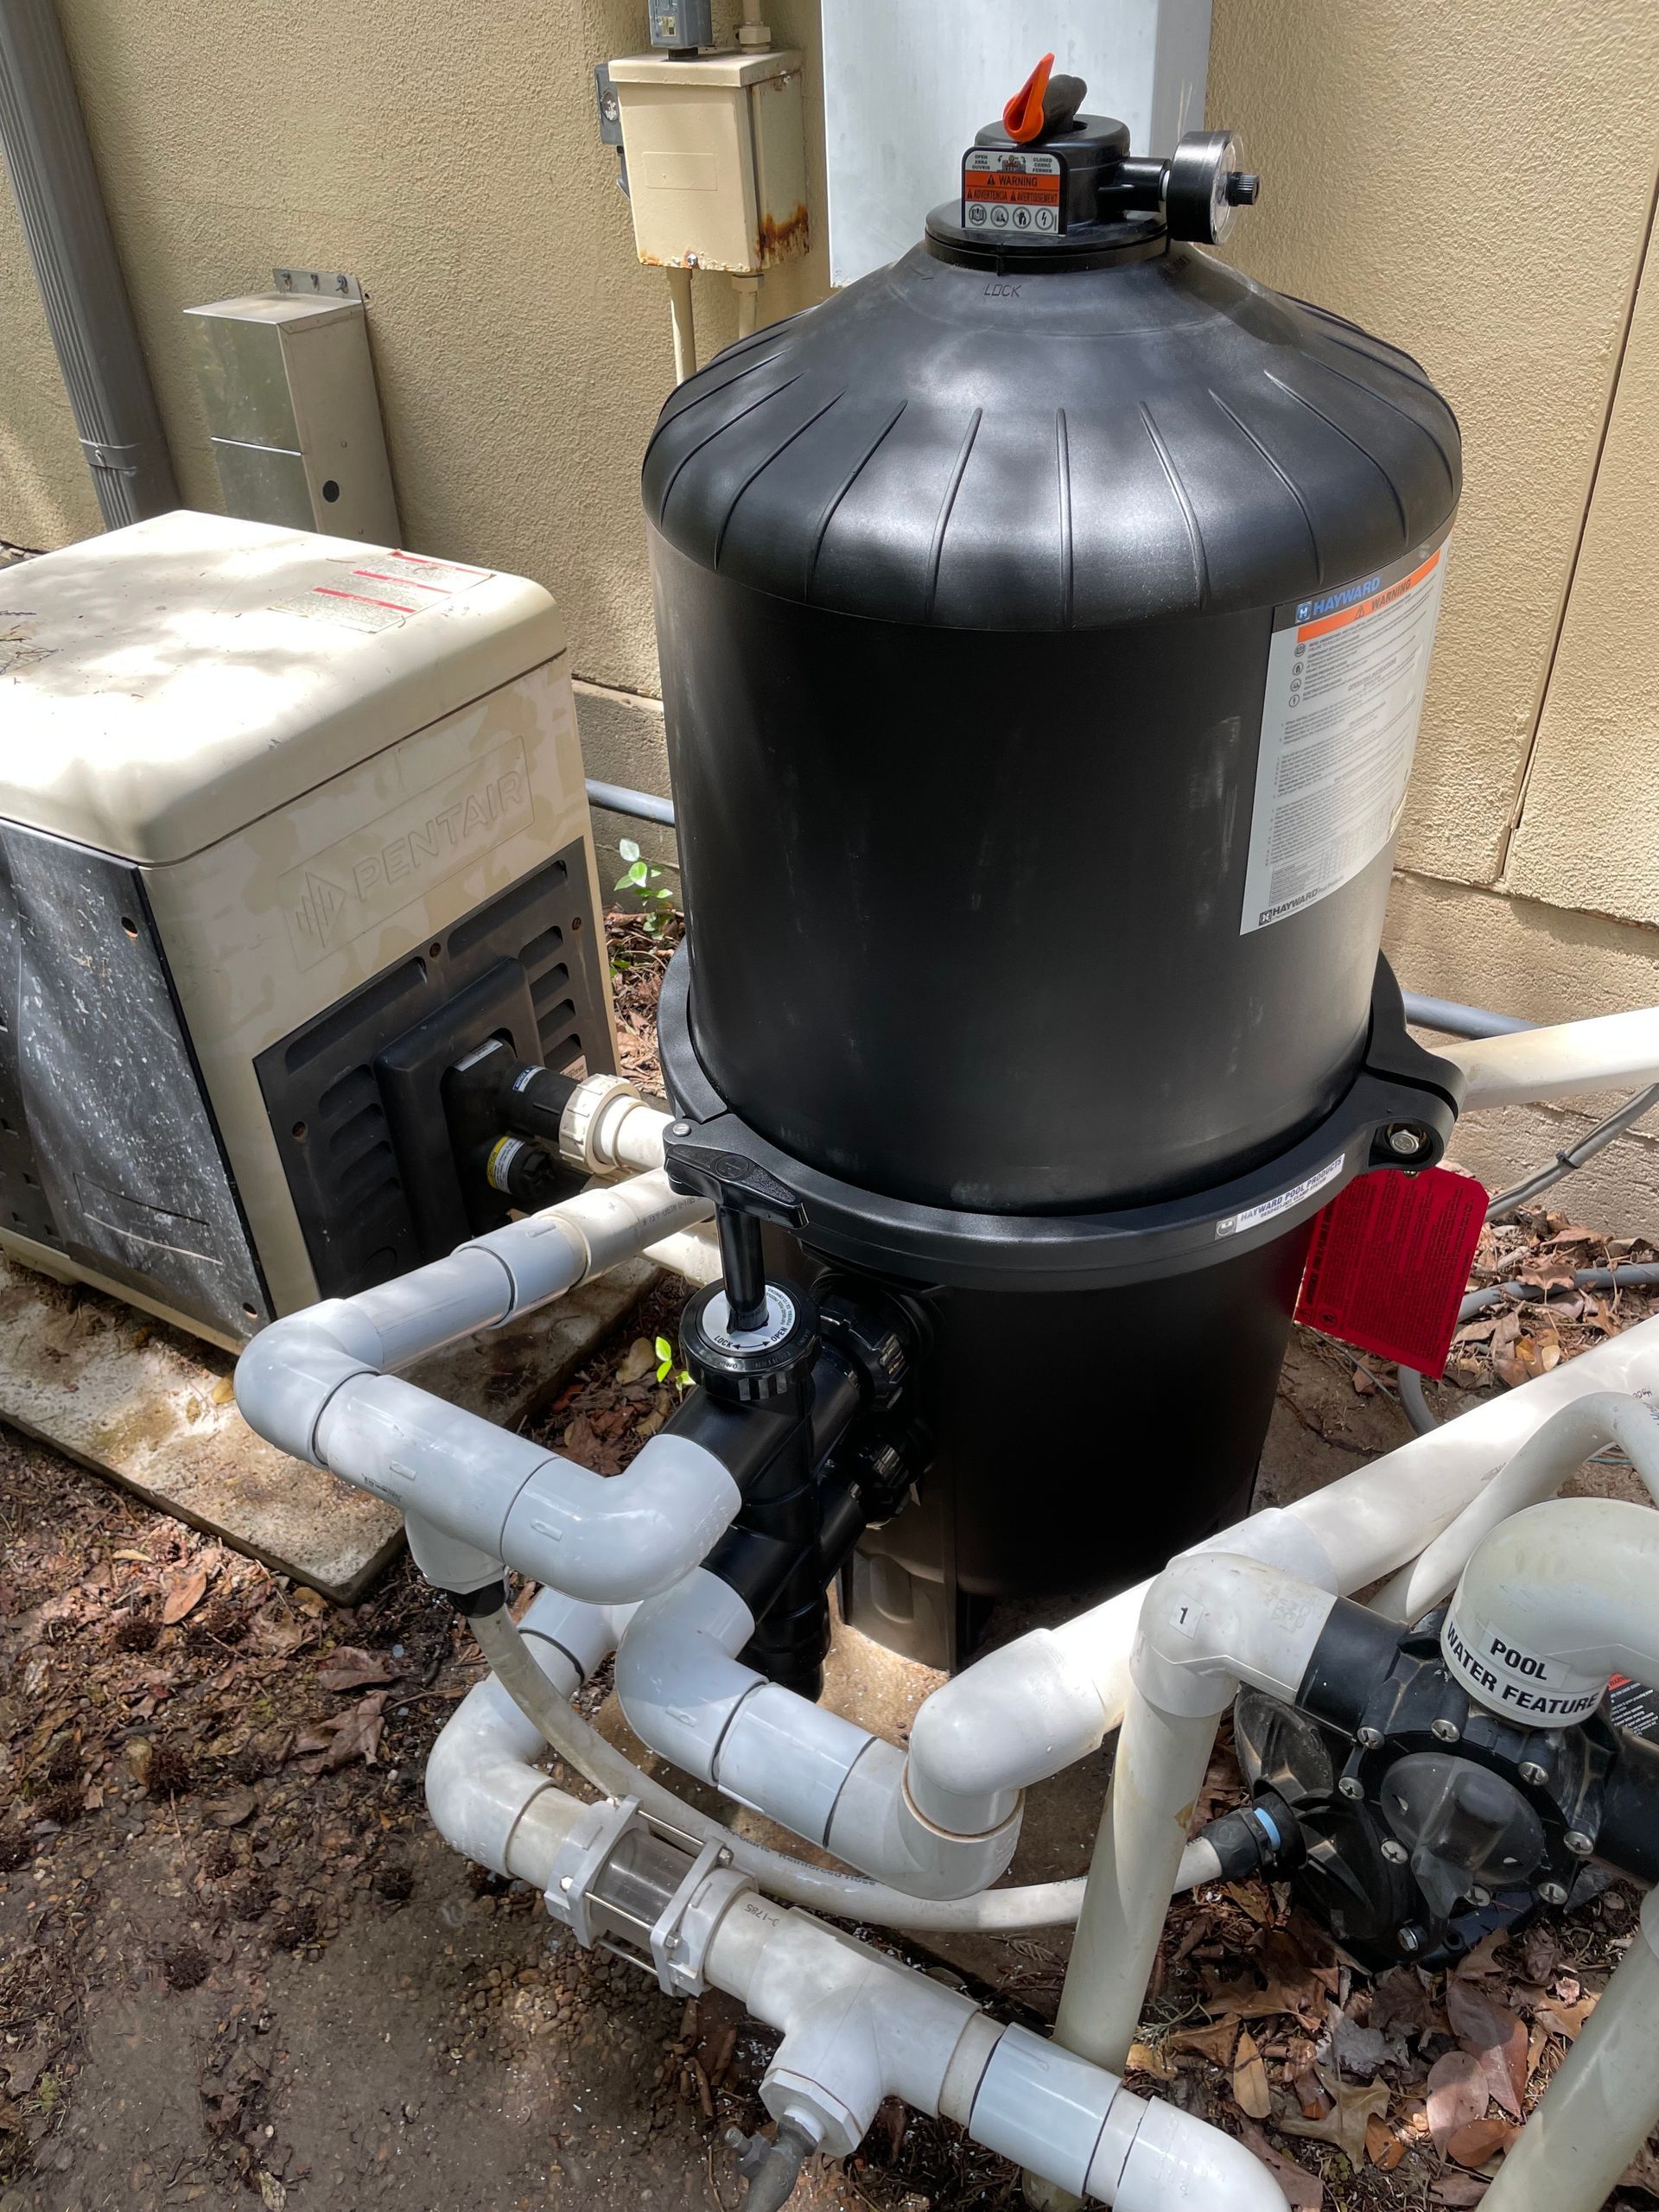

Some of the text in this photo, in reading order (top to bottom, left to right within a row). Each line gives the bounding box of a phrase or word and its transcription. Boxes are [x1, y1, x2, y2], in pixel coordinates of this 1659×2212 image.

[974, 189, 1007, 200] ADVERTENCIA
[999, 176, 1038, 188] WARNING
[1017, 192, 1058, 202] AVERTISSEMENT
[983, 283, 1022, 298] LOCK
[1313, 576, 1381, 615] HAYWARD
[1370, 579, 1412, 611] WARNING
[352, 769, 524, 904] PENTAIR
[1273, 887, 1319, 917] HAYWARD
[1240, 1196, 1283, 1222] HAYWARD
[1285, 1184, 1305, 1200] POOL
[1306, 1157, 1342, 1186] PRODUCTS
[714, 1335, 734, 1349] LOCK
[770, 1326, 789, 1342] OPEN
[1179, 1606, 1189, 1624] 1
[1447, 1621, 1497, 1692] WATER
[1502, 1687, 1599, 1714] FEATURE
[1491, 1637, 1548, 1681] POOL
[779, 1853, 842, 1878] Reinforced
[844, 1875, 876, 1886] Hose
